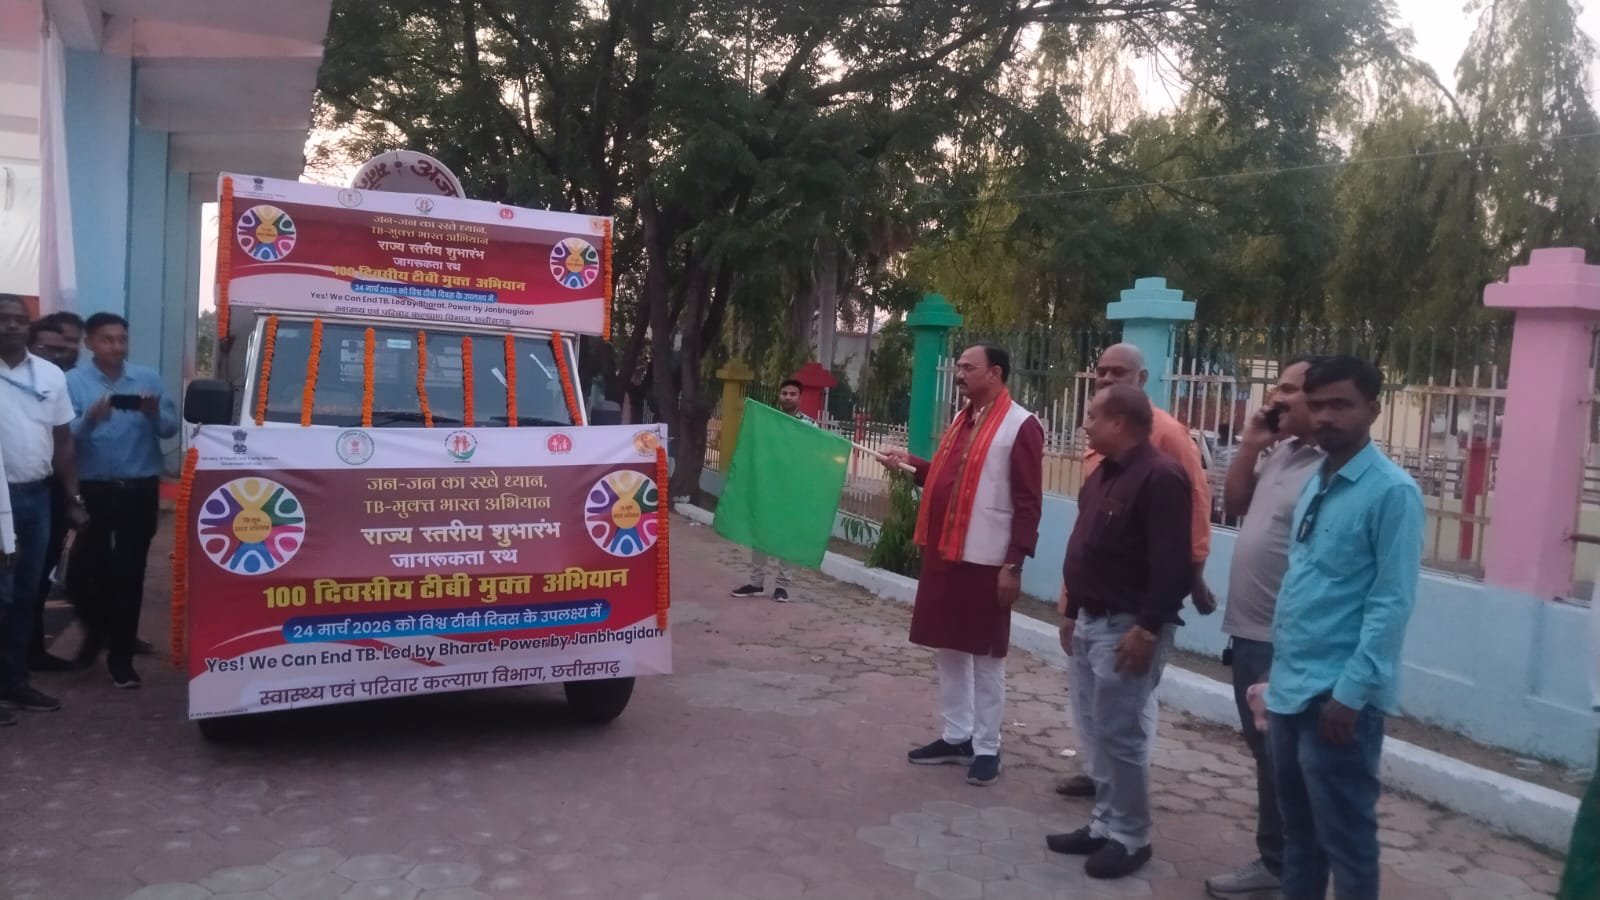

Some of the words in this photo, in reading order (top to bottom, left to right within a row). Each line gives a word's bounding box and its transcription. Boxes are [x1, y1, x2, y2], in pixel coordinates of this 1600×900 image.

[377, 240, 405, 253] राज्य
[408, 242, 443, 256] स्तरीय
[445, 247, 485, 261] शुभारंभ
[393, 257, 443, 270] जागरूकता
[446, 262, 461, 272] रथ
[310, 291, 328, 300] Yes!
[330, 293, 343, 301] We
[344, 294, 361, 302] Can
[363, 295, 378, 303] End
[391, 298, 405, 306] Led
[448, 304, 471, 312] Power
[473, 304, 483, 313] by
[484, 306, 535, 316] Janbhagidari
[366, 477, 437, 491] जन-जन
[440, 476, 465, 490] का
[440, 498, 480, 512] भारत
[485, 492, 551, 511] अभियान
[360, 527, 413, 545] राज्य
[419, 519, 483, 543] स्तरीय
[488, 518, 561, 548] शुभारंभ
[389, 550, 485, 569] जागरूकता
[489, 548, 518, 564] रथ
[263, 586, 307, 608] 100
[313, 576, 415, 605] दिवसीय
[420, 572, 472, 599] टीबी
[478, 575, 533, 602] मुक्त
[543, 567, 629, 593] अभियान
[293, 624, 314, 639] 24
[317, 618, 351, 637] मार्च
[353, 620, 391, 635] 2026
[394, 616, 416, 632] को
[418, 613, 448, 630] विश्व
[450, 611, 481, 628] टीबी
[483, 610, 521, 627] दिवस
[522, 608, 538, 624] के
[540, 607, 588, 622] उपलक्ष्य
[590, 602, 602, 618] में
[207, 658, 244, 673] Yes!
[249, 655, 278, 670] We
[281, 653, 317, 667] Can
[321, 648, 351, 664] End
[355, 647, 380, 662] TB.
[383, 644, 411, 660] Led
[415, 643, 435, 661] by
[500, 638, 548, 652] Power
[550, 634, 568, 651] by
[259, 684, 325, 705] स्वास्थ्य
[329, 679, 356, 698] एवं
[360, 675, 419, 696] परिवार
[422, 671, 488, 690] कल्याण
[492, 665, 546, 684] विभाग,
[551, 659, 622, 678] छत्तीसगढ़
